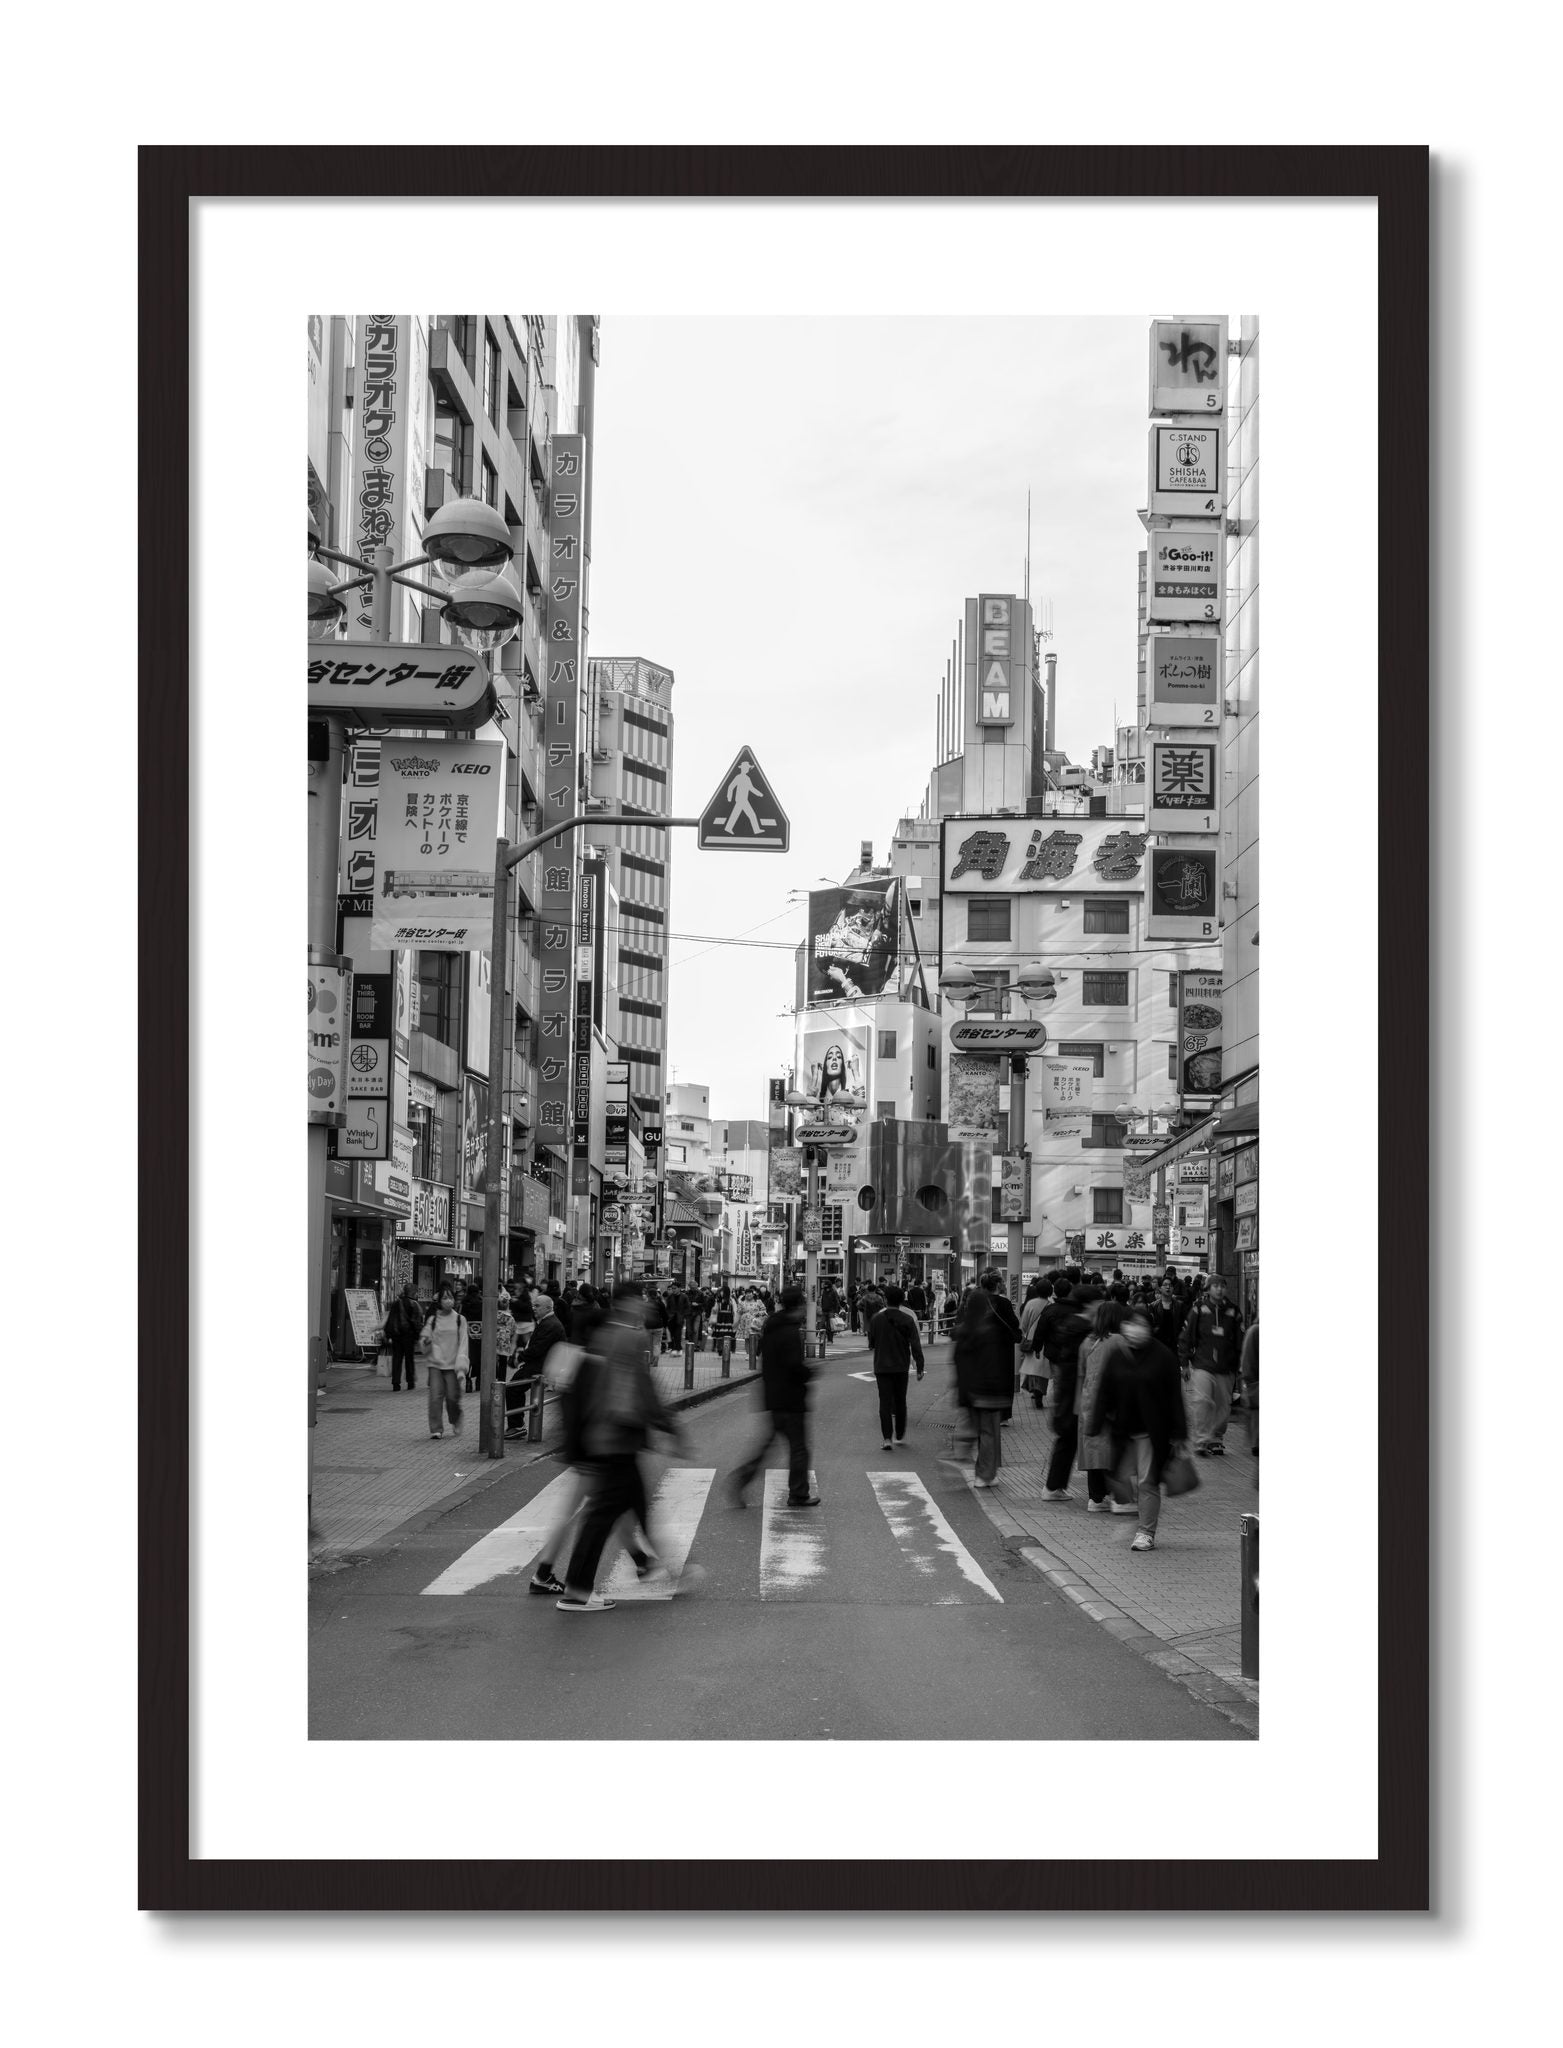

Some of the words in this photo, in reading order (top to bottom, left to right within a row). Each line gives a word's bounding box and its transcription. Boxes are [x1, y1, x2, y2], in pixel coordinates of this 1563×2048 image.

[363, 324, 398, 439] カラオケ
[1206, 394, 1217, 407] 5
[1169, 433, 1207, 442] C.STAND
[1169, 467, 1207, 476] SHISHA
[1169, 476, 1207, 484] CAFE&BAR
[1168, 548, 1214, 562] Goo-it!
[1158, 585, 1214, 596] 全身もみほぐし
[1204, 604, 1215, 618] 3
[983, 598, 1010, 719] BEAM
[1159, 663, 1212, 680] ポムの樹
[1203, 709, 1214, 723] 2
[450, 763, 491, 775] KEIO
[1162, 749, 1204, 793] 薬
[1156, 794, 1208, 807] マツモトキヨシ
[405, 793, 419, 829] 冒険へ
[420, 793, 436, 855] カントーの
[455, 794, 470, 843] 京王線で
[1203, 816, 1211, 829] 1
[950, 829, 1150, 881] 角海老
[1157, 863, 1208, 902] 一蘭
[582, 879, 590, 909] kimono
[582, 912, 590, 941] hearts
[1202, 922, 1213, 936] B
[394, 928, 469, 940] 渋谷センター街
[540, 924, 569, 1127] カラオケ館
[956, 1028, 1041, 1039] 渋谷センター街
[1184, 1035, 1208, 1051] 6F
[317, 1075, 334, 1087] Day!
[346, 1129, 374, 1139] Whisky
[346, 1137, 363, 1145] Bank
[644, 1132, 661, 1141] GU
[1096, 1231, 1146, 1249] 兆楽
